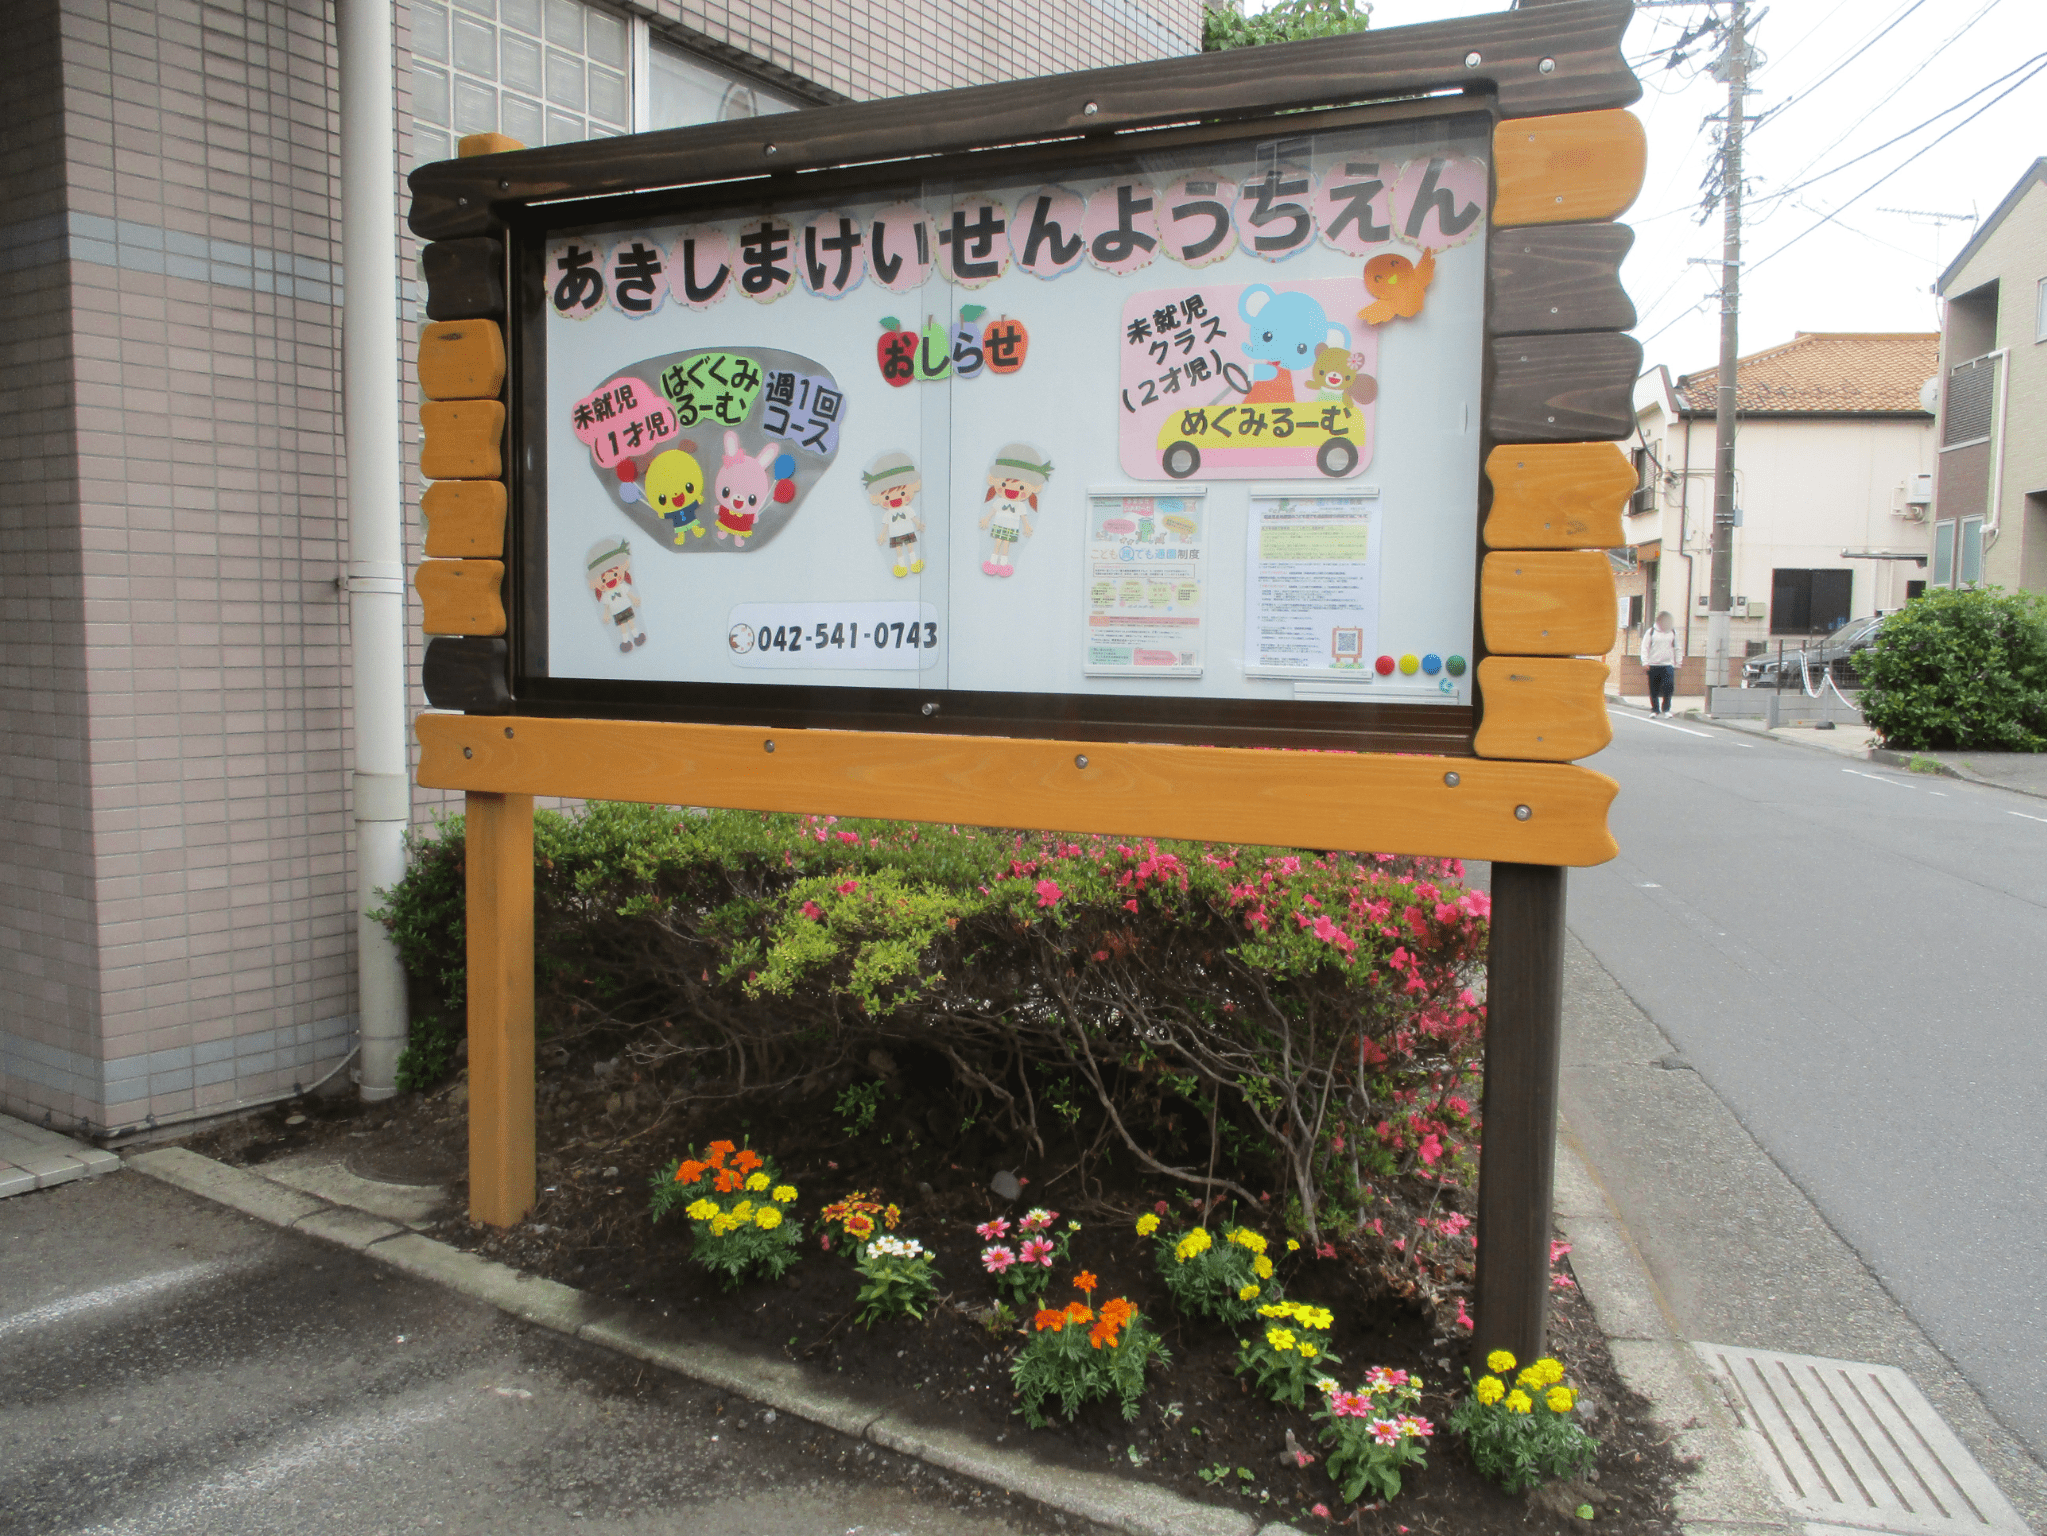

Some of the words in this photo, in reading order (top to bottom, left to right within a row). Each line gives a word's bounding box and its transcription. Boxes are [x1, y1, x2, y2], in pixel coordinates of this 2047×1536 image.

[552, 157, 1482, 312] あきしまけいせんようちえん
[1126, 293, 1208, 346] 未就児
[1147, 315, 1228, 366] クラス
[661, 354, 760, 400] はぐくみ
[883, 325, 1022, 380] おしらせ
[573, 384, 638, 431] 未就児
[676, 391, 747, 427] るーむ
[764, 370, 844, 422] 週1回
[763, 405, 830, 454] コース
[757, 621, 938, 652] 042-541-0743
